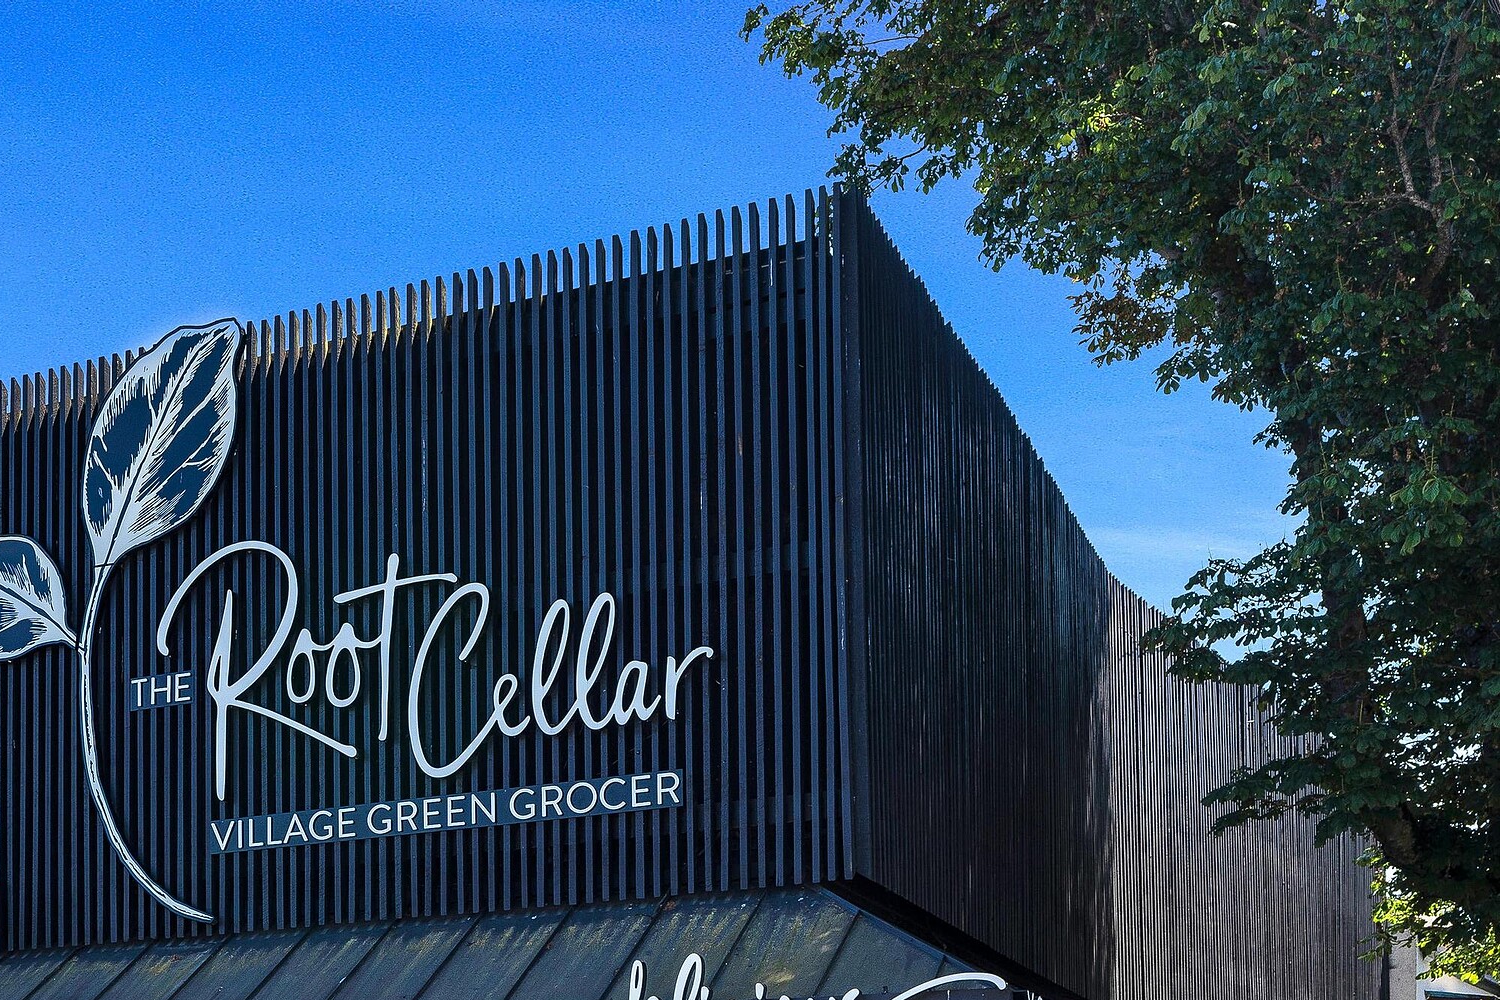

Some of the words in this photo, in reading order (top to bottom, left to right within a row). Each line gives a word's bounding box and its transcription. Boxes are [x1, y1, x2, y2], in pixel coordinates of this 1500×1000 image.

[131, 672, 191, 708] THE
[156, 540, 458, 801] Root
[408, 582, 714, 778] Cellar
[211, 806, 356, 851] VILLAGE
[366, 791, 497, 836] GREEN
[508, 772, 681, 821] GROCER
